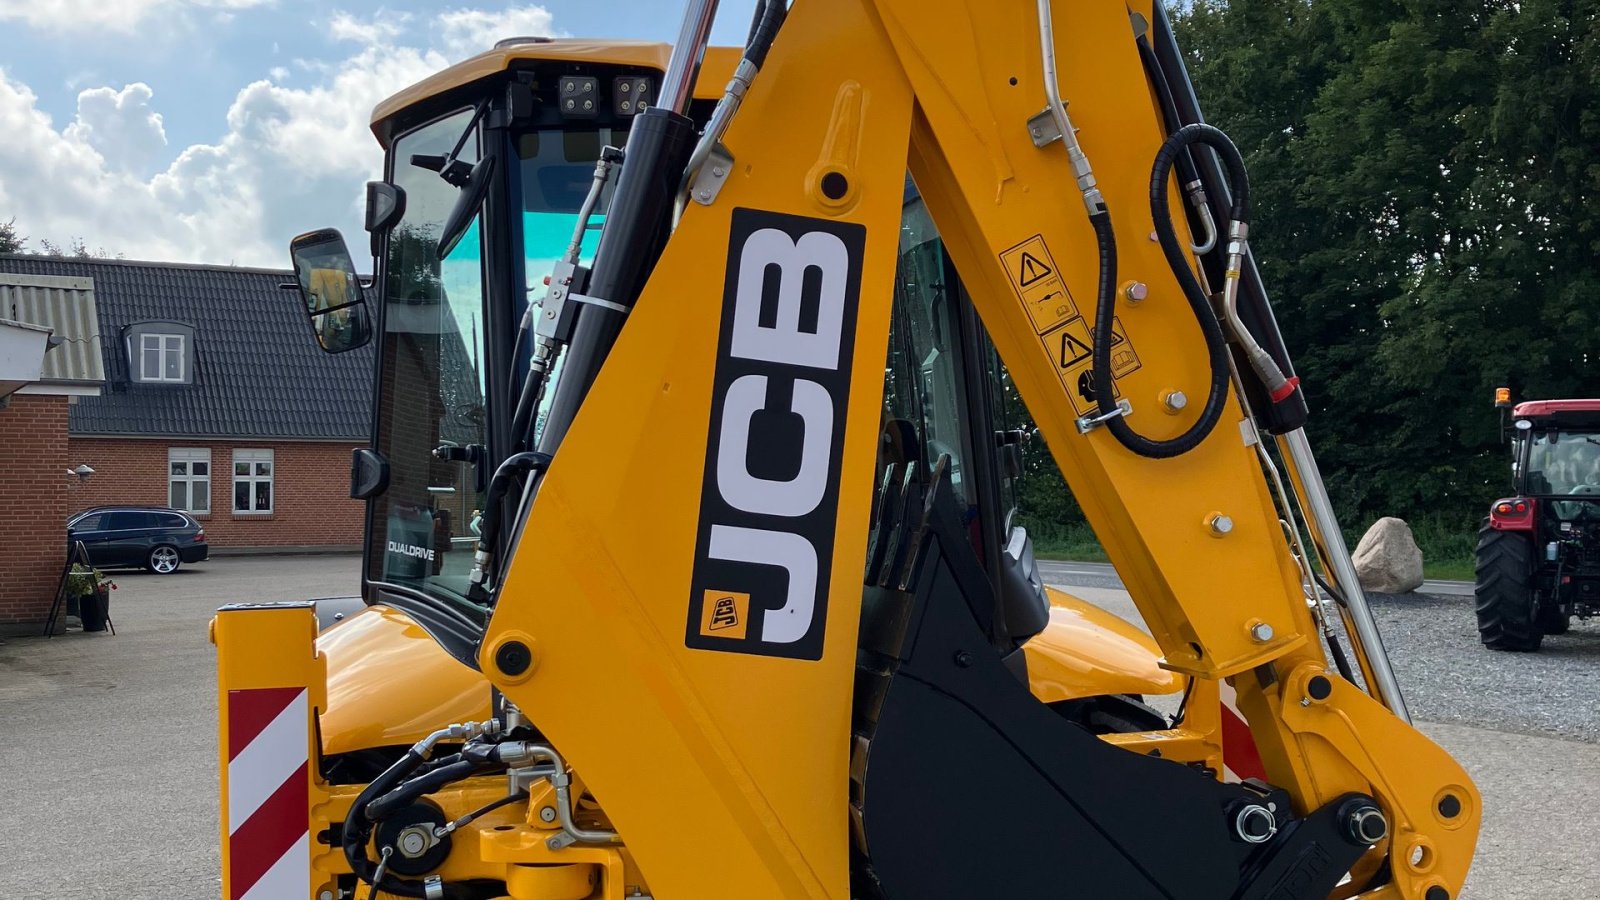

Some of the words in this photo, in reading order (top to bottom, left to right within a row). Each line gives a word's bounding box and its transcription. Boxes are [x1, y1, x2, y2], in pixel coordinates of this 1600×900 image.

[708, 228, 849, 643] JCB
[388, 541, 435, 561] DUALDRIVE
[713, 599, 736, 625] JCB
